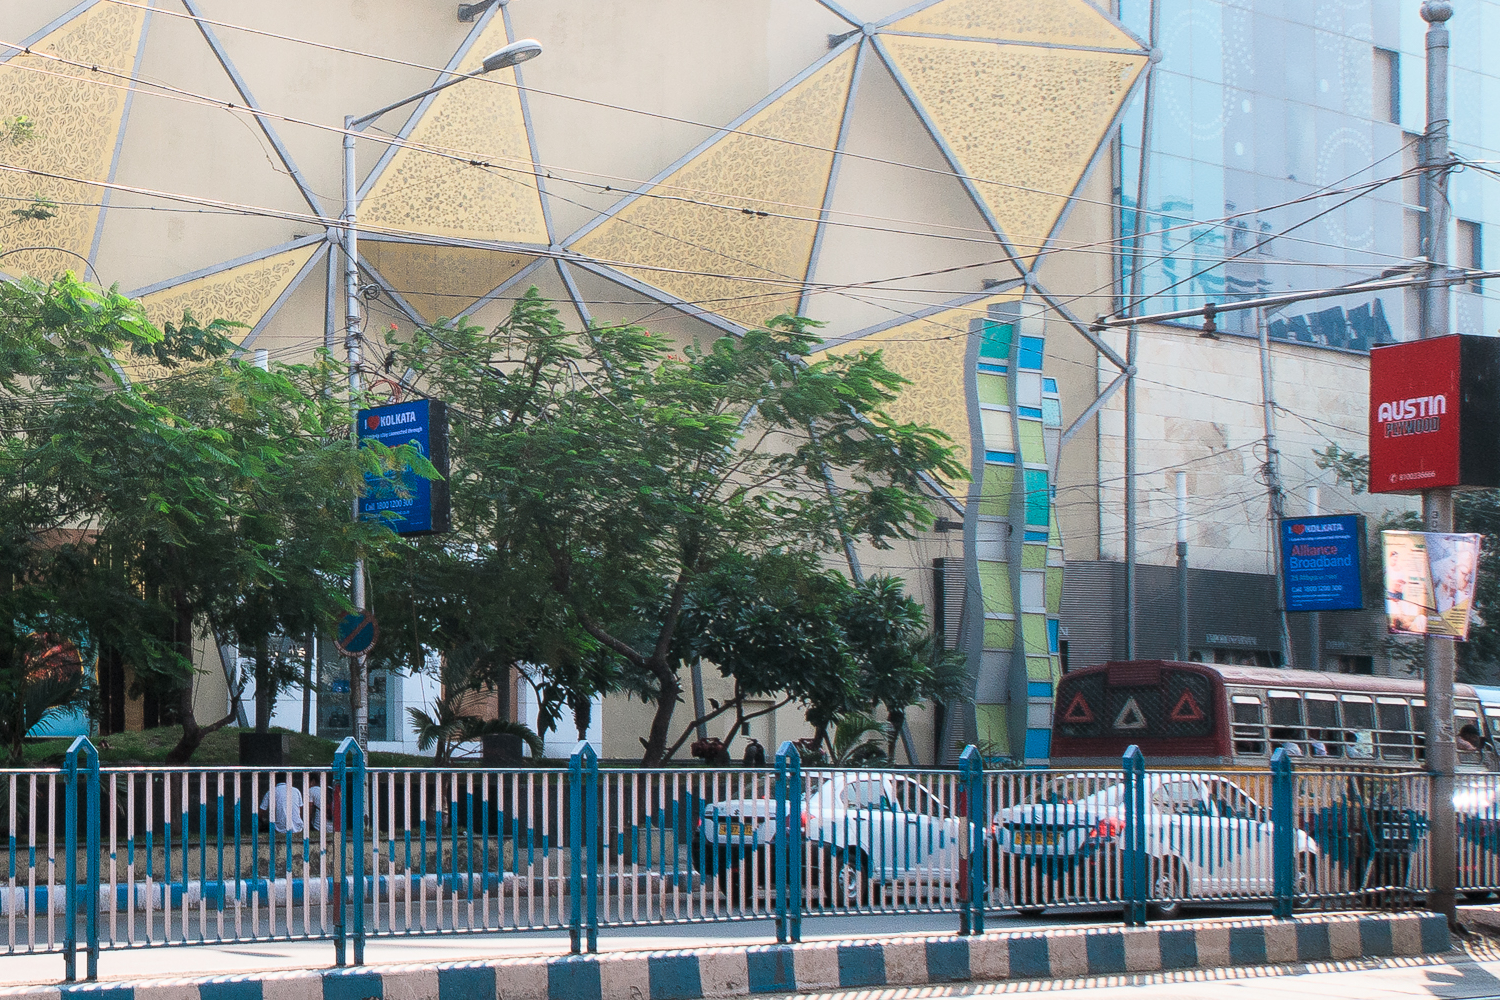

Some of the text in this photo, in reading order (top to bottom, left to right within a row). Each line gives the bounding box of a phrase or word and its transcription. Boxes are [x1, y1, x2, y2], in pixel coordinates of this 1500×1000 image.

[1378, 394, 1446, 423] AUSTIN
[380, 411, 416, 427] KOLKATA
[1384, 415, 1440, 438] PLYWOOD
[376, 500, 389, 510] 1800
[390, 499, 402, 508] 1200
[1305, 523, 1344, 533] KOLKATA
[1291, 544, 1338, 556] Alliance
[1289, 554, 1351, 569] Broadband
